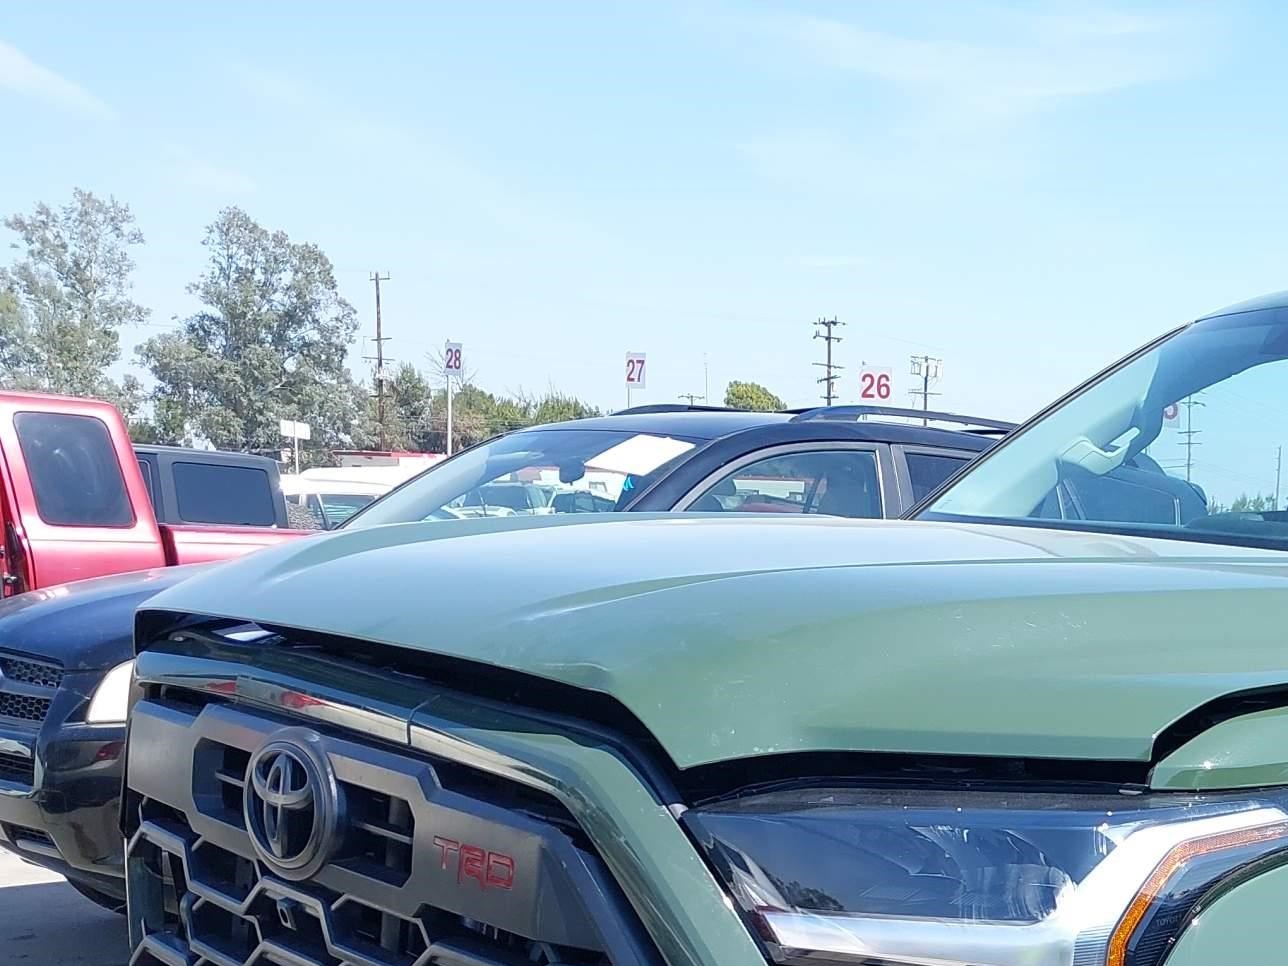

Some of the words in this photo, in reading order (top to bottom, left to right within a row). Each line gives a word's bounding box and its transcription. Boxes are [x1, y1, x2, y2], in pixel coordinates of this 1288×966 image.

[446, 348, 462, 370] 28
[626, 359, 645, 383] 27
[861, 373, 891, 399] 26
[432, 835, 516, 891] TRD
